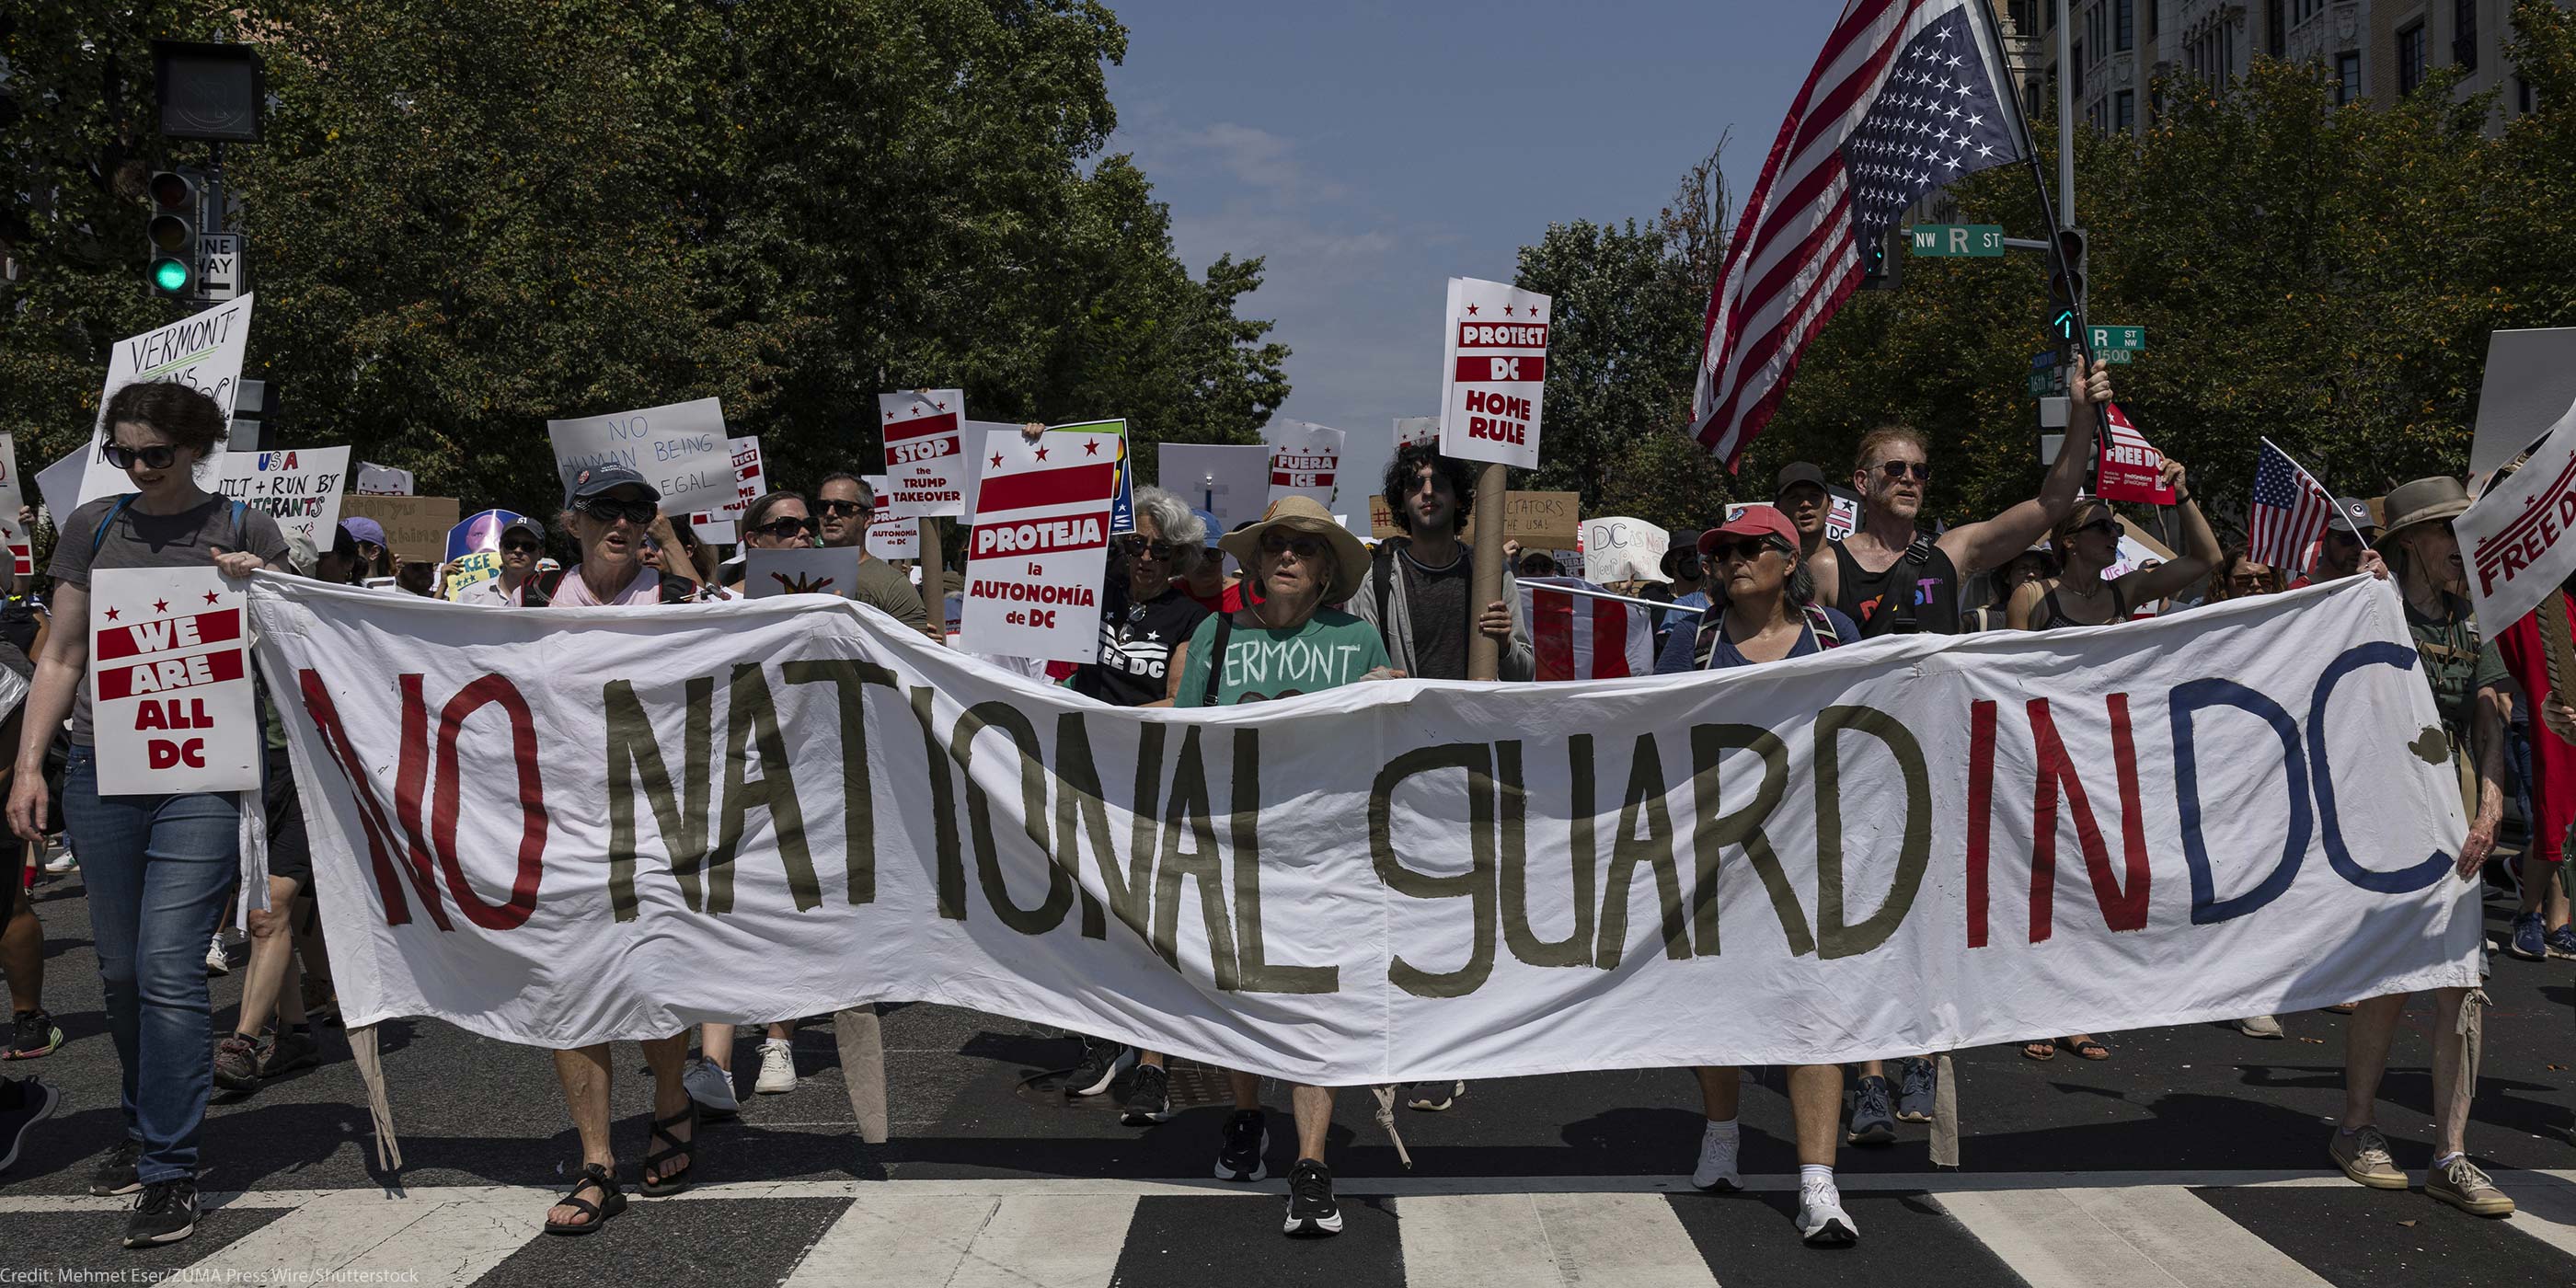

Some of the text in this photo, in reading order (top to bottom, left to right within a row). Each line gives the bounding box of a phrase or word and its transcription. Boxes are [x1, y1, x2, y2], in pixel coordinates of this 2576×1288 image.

[1915, 227, 2001, 254] NW R ST
[132, 307, 239, 374] VERMONT
[1463, 326, 1545, 345] PROTECT
[2094, 329, 2137, 347] R ST
[2096, 350, 2130, 362] 1500
[1490, 357, 1520, 381] DC
[1466, 389, 1532, 421] HOME
[608, 416, 649, 441] NO
[1468, 416, 1525, 445] RULE
[654, 434, 713, 462] BEING
[894, 439, 949, 464] STOP
[2106, 445, 2143, 466] FREE
[258, 451, 299, 472] USA
[915, 466, 931, 475] the
[1278, 455, 1335, 470] FUERA
[271, 475, 310, 496] RUN
[316, 474, 340, 493] BY
[903, 477, 947, 489] TRUMP
[1289, 473, 1317, 487] ICE
[892, 490, 960, 502] TAKEOVER
[516, 516, 528, 524] 51
[1526, 519, 1549, 530] USA!
[872, 529, 918, 537] AUTONOMÍA
[978, 518, 1102, 556] PROTEJA
[1593, 523, 1628, 551] DC
[2478, 511, 2561, 598] FREE
[1028, 561, 1043, 576] la
[970, 580, 1095, 607] AUTONOMÍA
[1006, 609, 1056, 629] de DC
[129, 615, 202, 654] WE
[131, 654, 214, 696] ARE
[1129, 657, 1166, 679] DC
[134, 698, 214, 730] ALL
[148, 738, 206, 770] DC
[299, 667, 549, 933] NO
[605, 659, 1340, 995] NATIONAL
[1967, 691, 2150, 949] IN
[2169, 640, 2455, 925] DC
